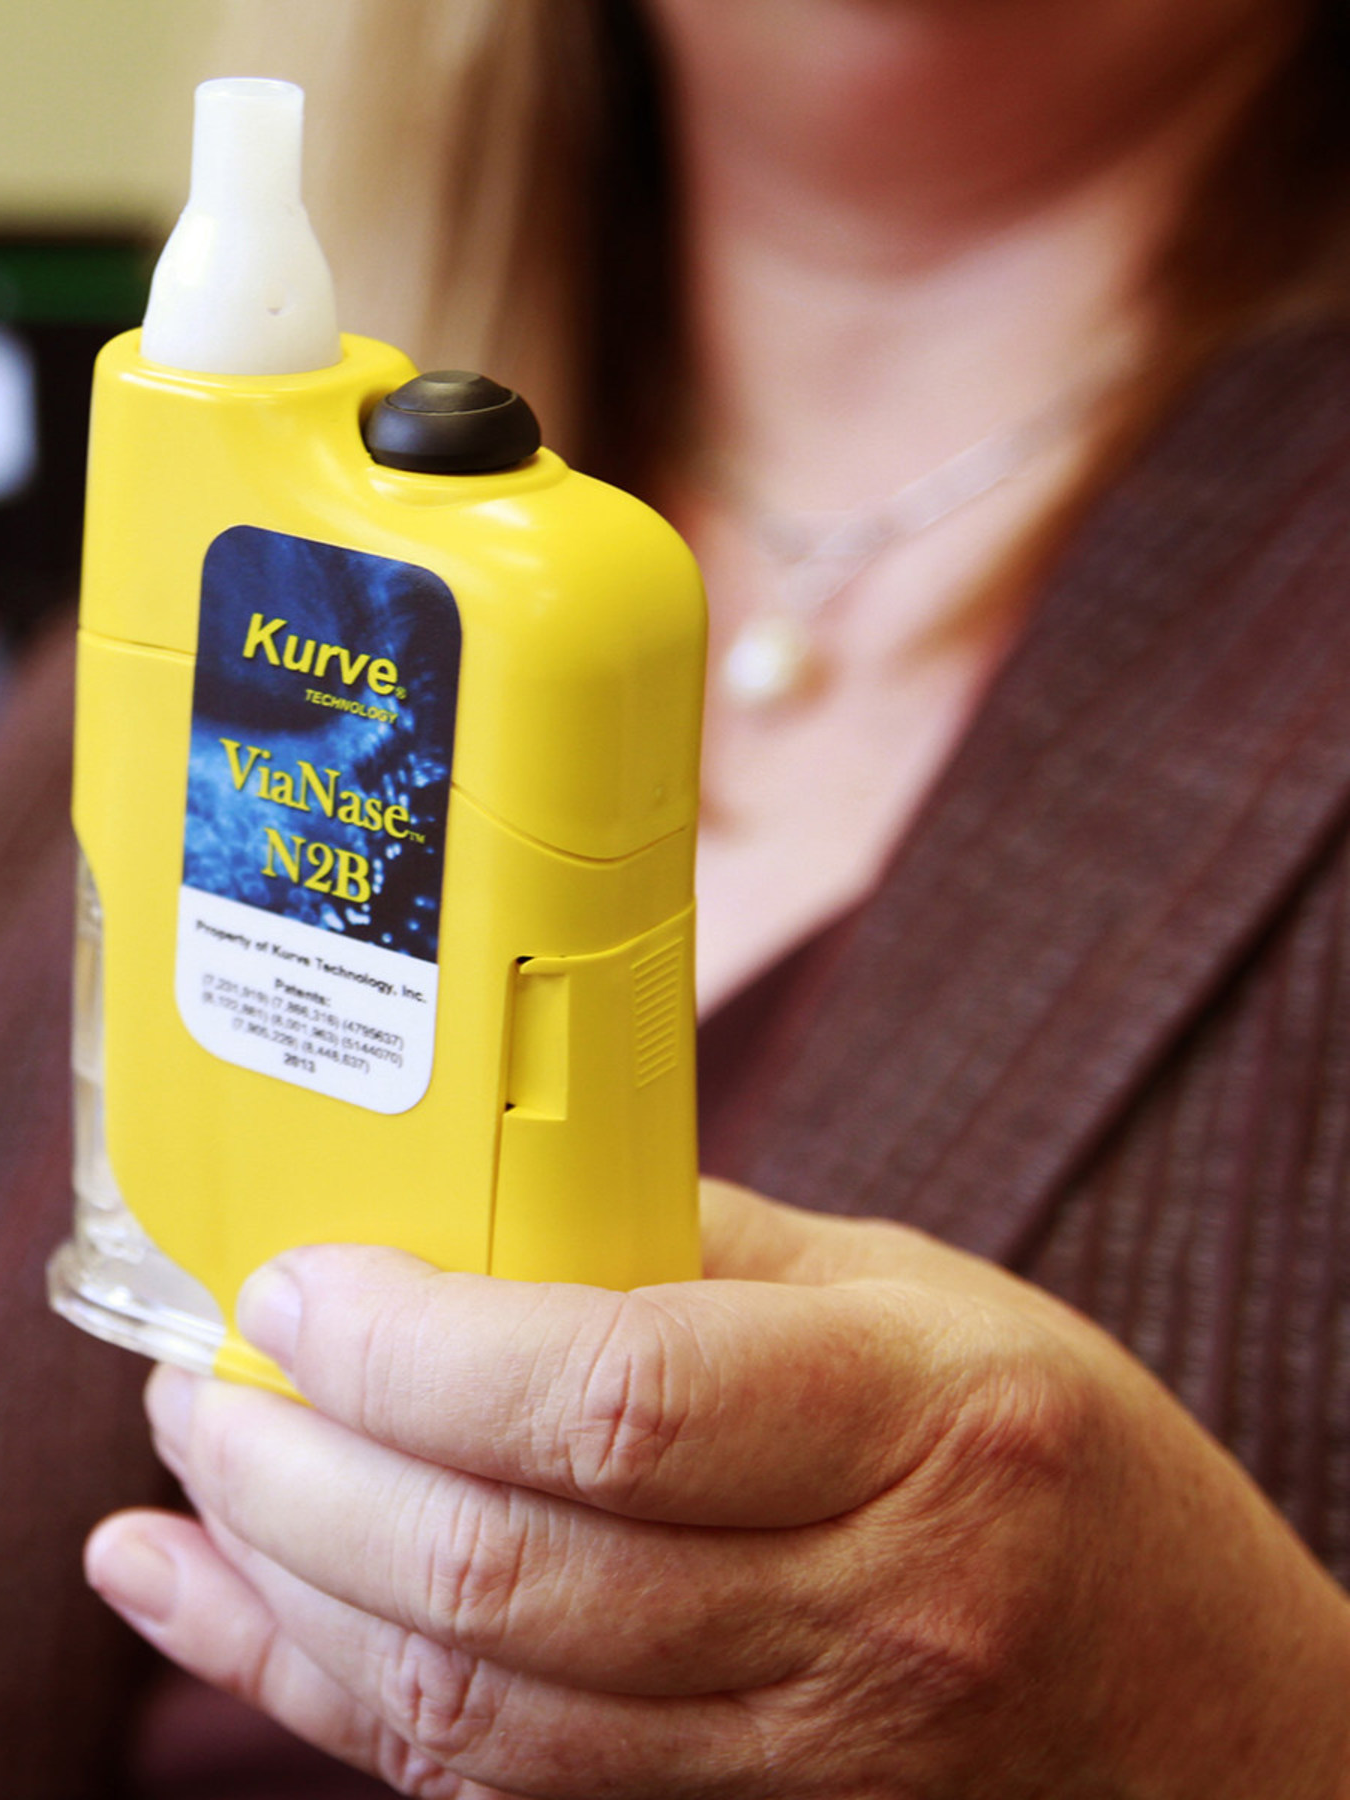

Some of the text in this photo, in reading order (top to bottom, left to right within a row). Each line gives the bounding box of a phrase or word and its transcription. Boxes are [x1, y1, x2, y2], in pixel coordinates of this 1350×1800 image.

[305, 688, 398, 724] TECHNOLOGY
[260, 827, 372, 904] N2B
[195, 919, 251, 950] Property
[255, 941, 269, 952] of
[272, 943, 311, 967] Kurve
[401, 984, 428, 1004] Inc.
[274, 977, 331, 1007] Patents:
[283, 1051, 317, 1075] 2013
